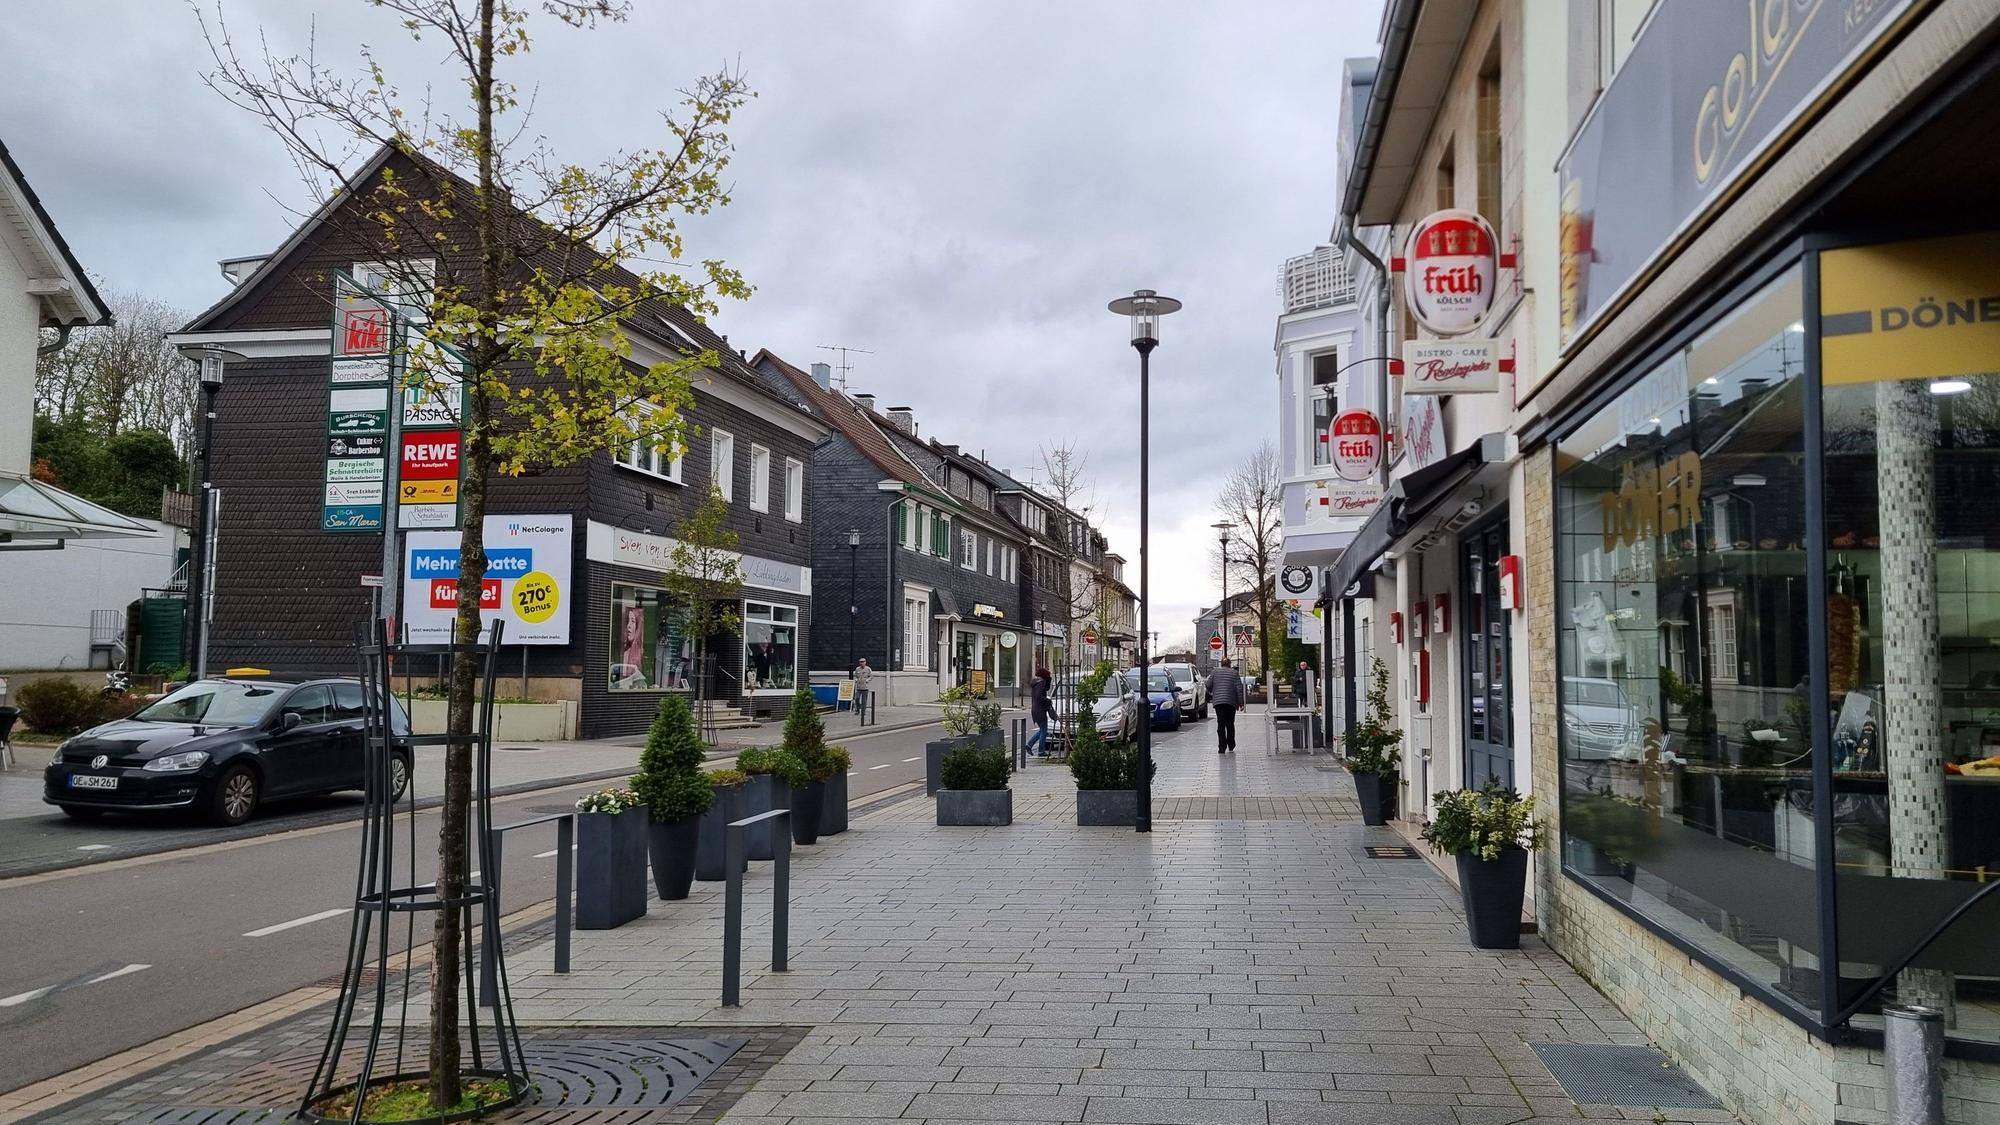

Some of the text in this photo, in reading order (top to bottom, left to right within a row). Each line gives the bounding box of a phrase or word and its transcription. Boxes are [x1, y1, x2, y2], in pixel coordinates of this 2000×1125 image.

[1436, 296, 1472, 305] KÖLSCH
[1880, 296, 2000, 332] DÖNE
[1417, 349, 1453, 357] BISTRO
[405, 407, 460, 422] PASSAGE
[348, 446, 381, 455] Barbershop
[404, 443, 457, 461] REWE
[1601, 450, 1703, 554] DÖNER
[521, 525, 564, 534] NetCologne
[415, 556, 457, 571] Mehr
[435, 585, 458, 600] für
[88, 776, 100, 787] SM
[101, 777, 117, 788] 261
